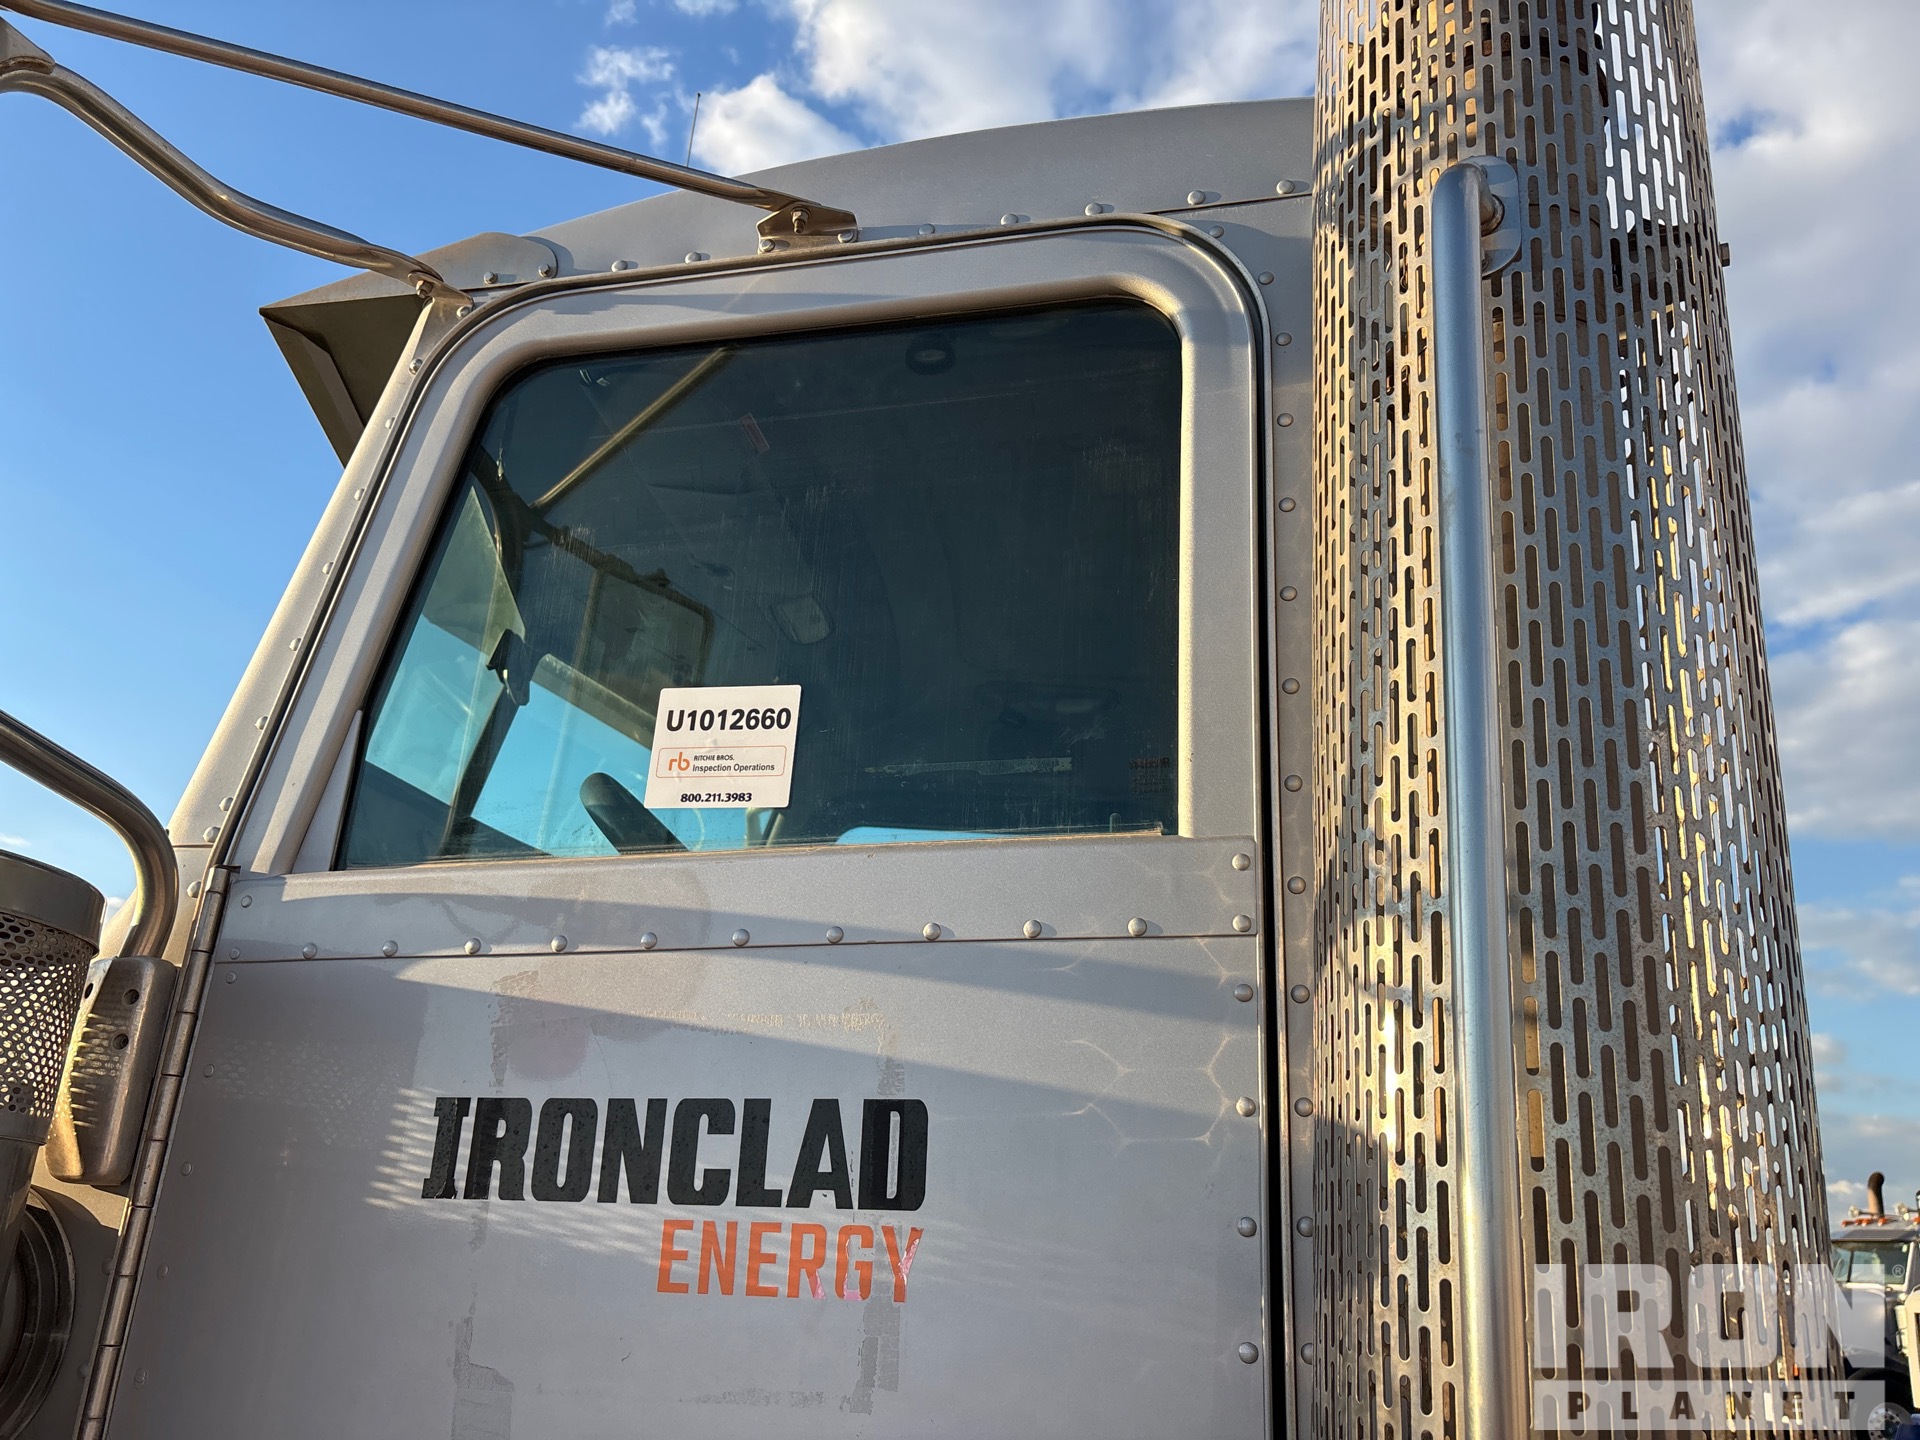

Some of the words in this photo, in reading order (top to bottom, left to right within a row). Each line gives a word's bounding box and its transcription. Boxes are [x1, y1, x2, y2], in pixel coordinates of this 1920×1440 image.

[666, 707, 792, 732] U1012660
[668, 751, 691, 772] rb
[692, 764, 732, 773] Inspection
[733, 763, 775, 772] Operations
[693, 754, 716, 762] RITCHIE
[680, 792, 753, 803] 800.211.3983
[421, 1096, 929, 1212] IRONCLAD
[656, 1219, 925, 1304] ENERGY
